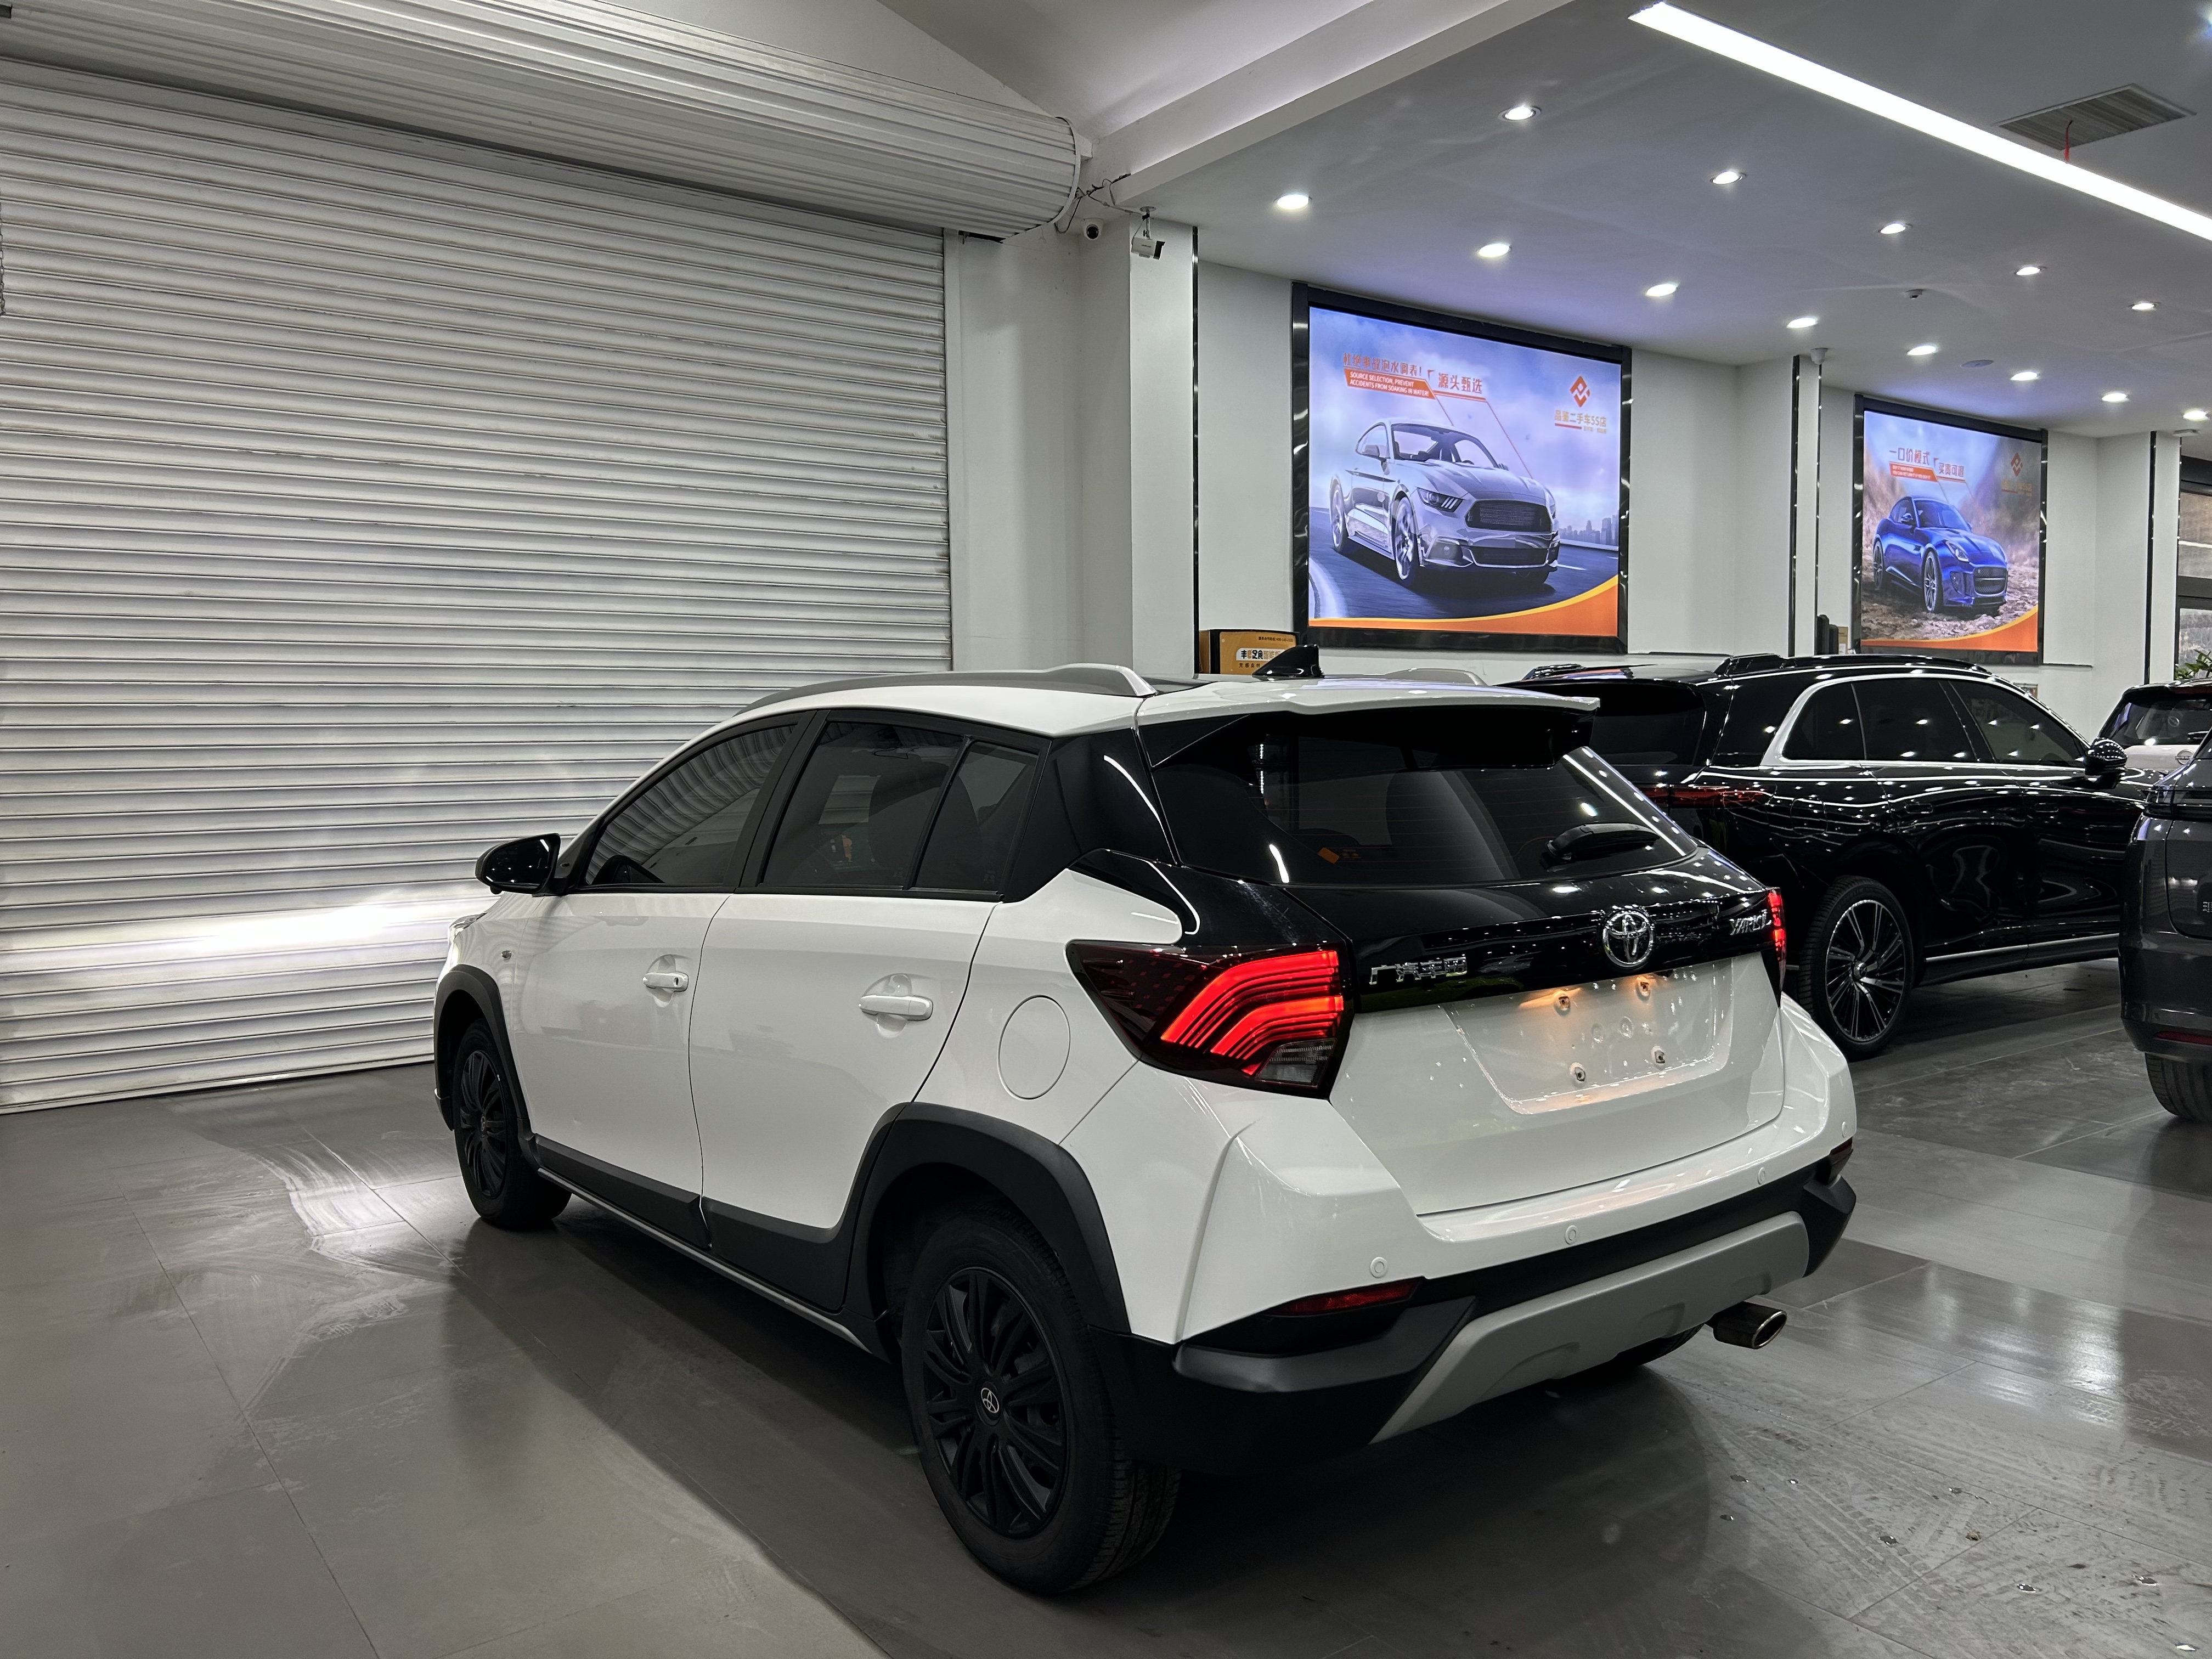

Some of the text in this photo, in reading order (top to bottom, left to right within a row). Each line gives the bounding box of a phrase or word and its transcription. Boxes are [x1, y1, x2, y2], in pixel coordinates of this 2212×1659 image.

[1350, 371, 1368, 380] SOURCE
[1395, 379, 1414, 387] PREVENT
[1350, 379, 1374, 388] ACCIDENTS
[1388, 385, 1407, 394] SOAKING
[1438, 373, 1482, 394] 源头甄选
[1889, 447, 1930, 466] 一口价模式
[1369, 956, 1468, 985] 广汽丰田
